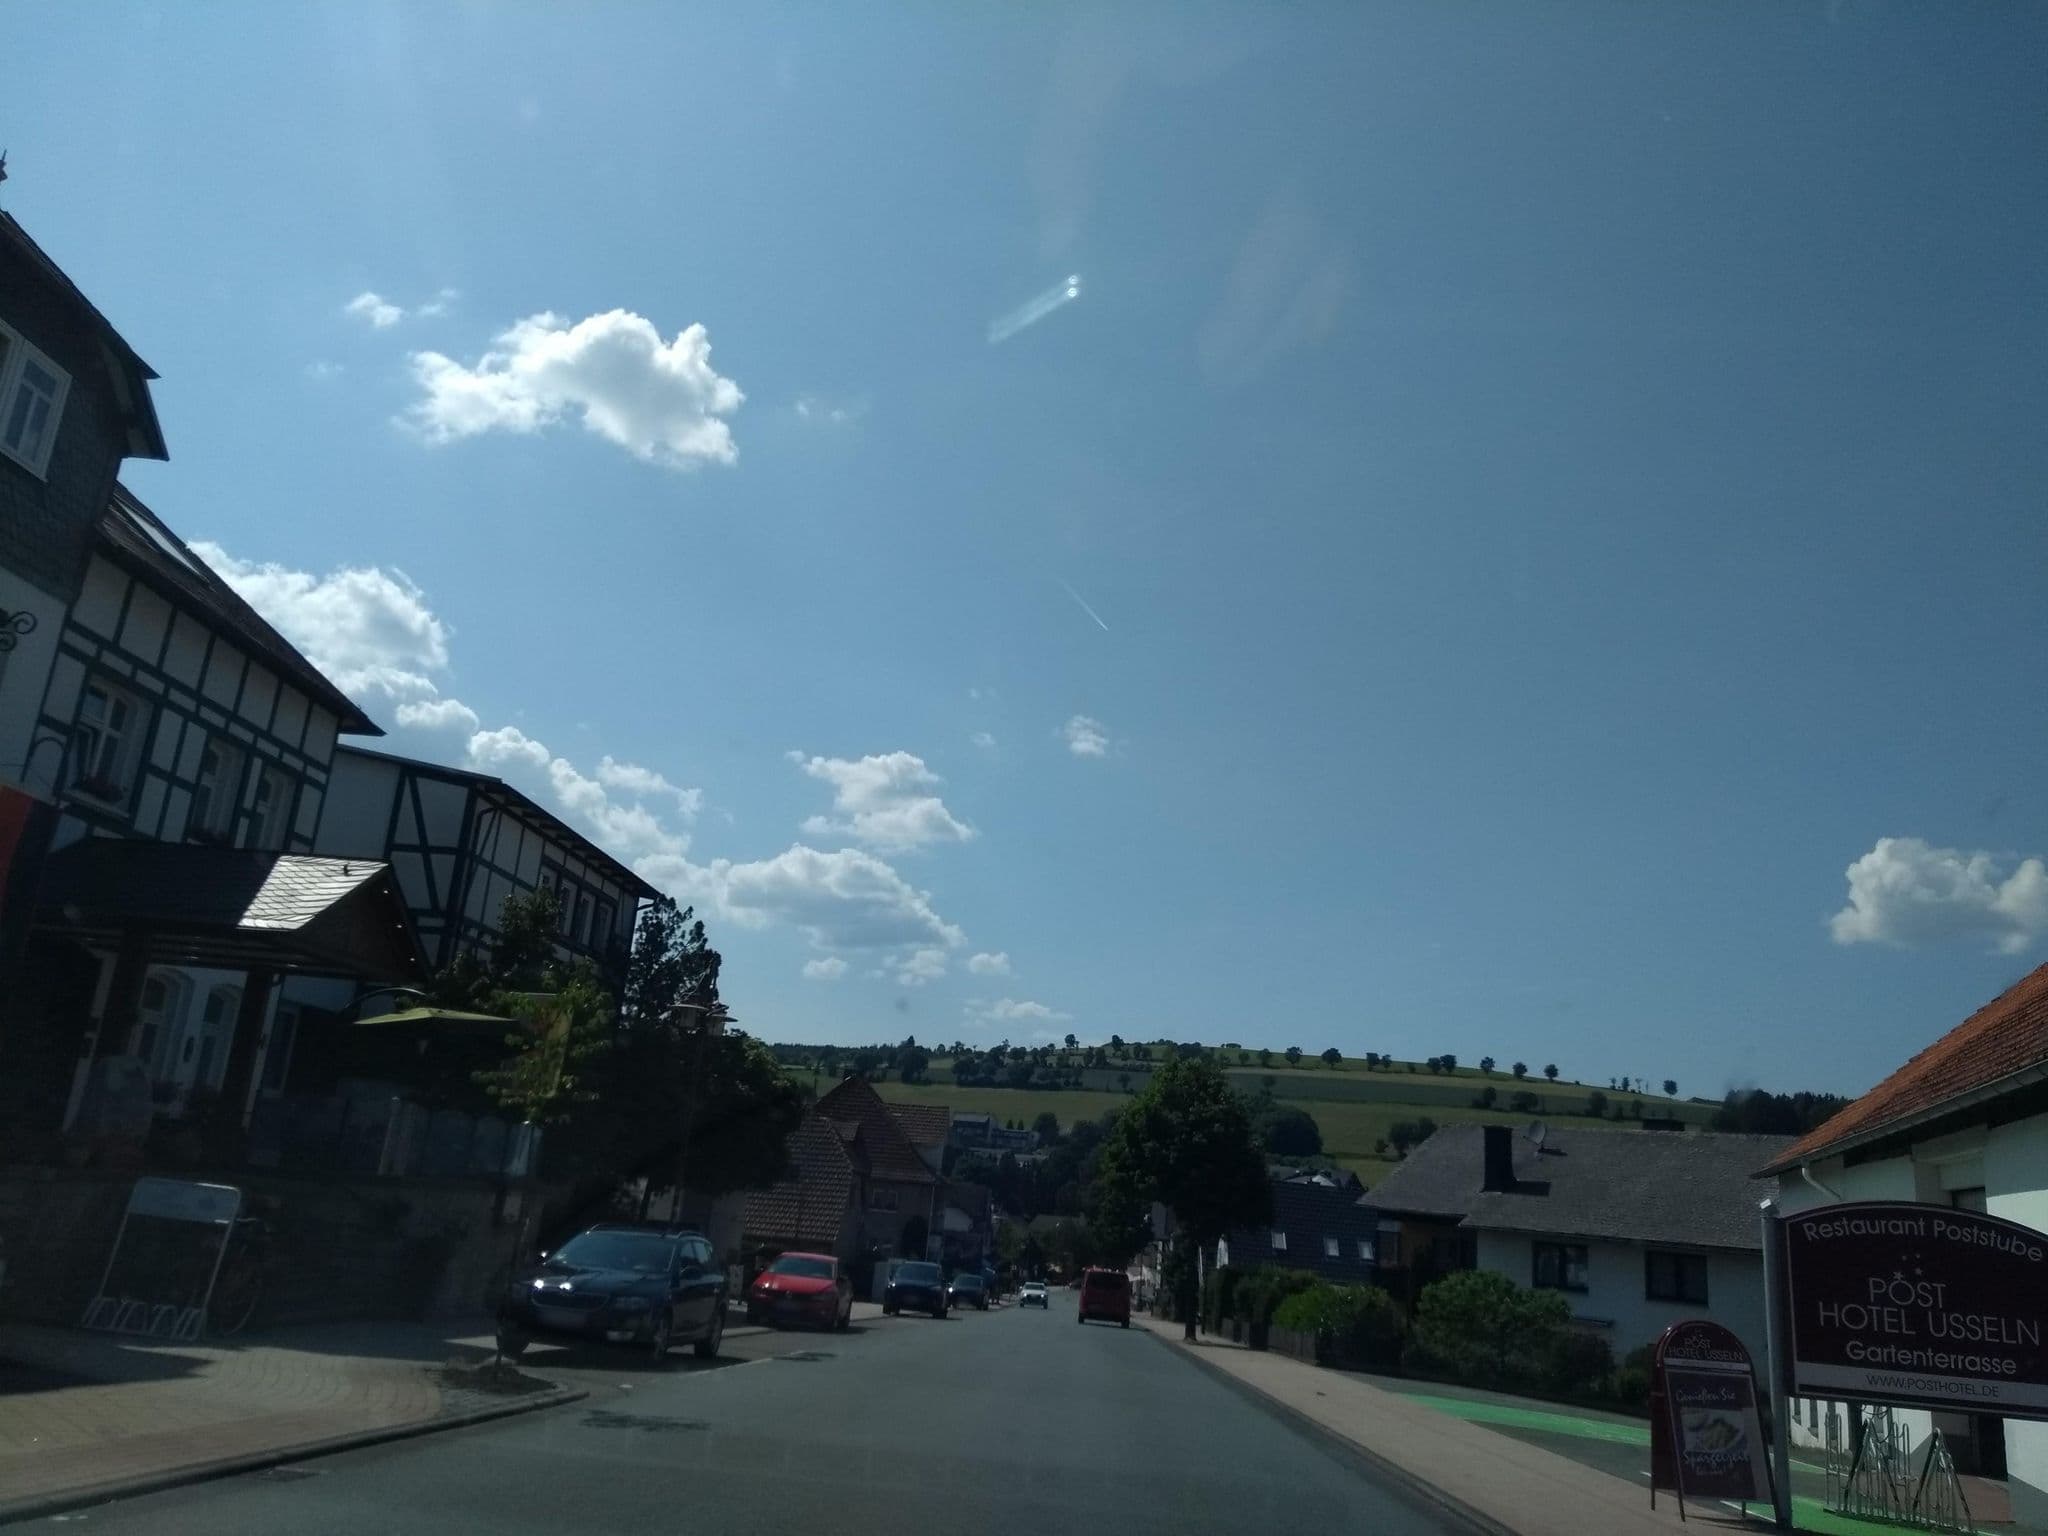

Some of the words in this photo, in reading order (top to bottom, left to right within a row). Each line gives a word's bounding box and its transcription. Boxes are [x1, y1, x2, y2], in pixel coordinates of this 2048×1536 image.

[1802, 1217, 1925, 1241] Restaurant
[1933, 1219, 2043, 1262] Poststube
[1868, 1277, 1947, 1308] POST
[1819, 1301, 1916, 1335] HOTEL
[1928, 1311, 2040, 1346] USSELN
[1668, 1346, 1701, 1359] HOTEL
[1845, 1340, 2017, 1375] Gartenterrasse
[1866, 1374, 2000, 1398] WWW.POSTHOTEL.DE
